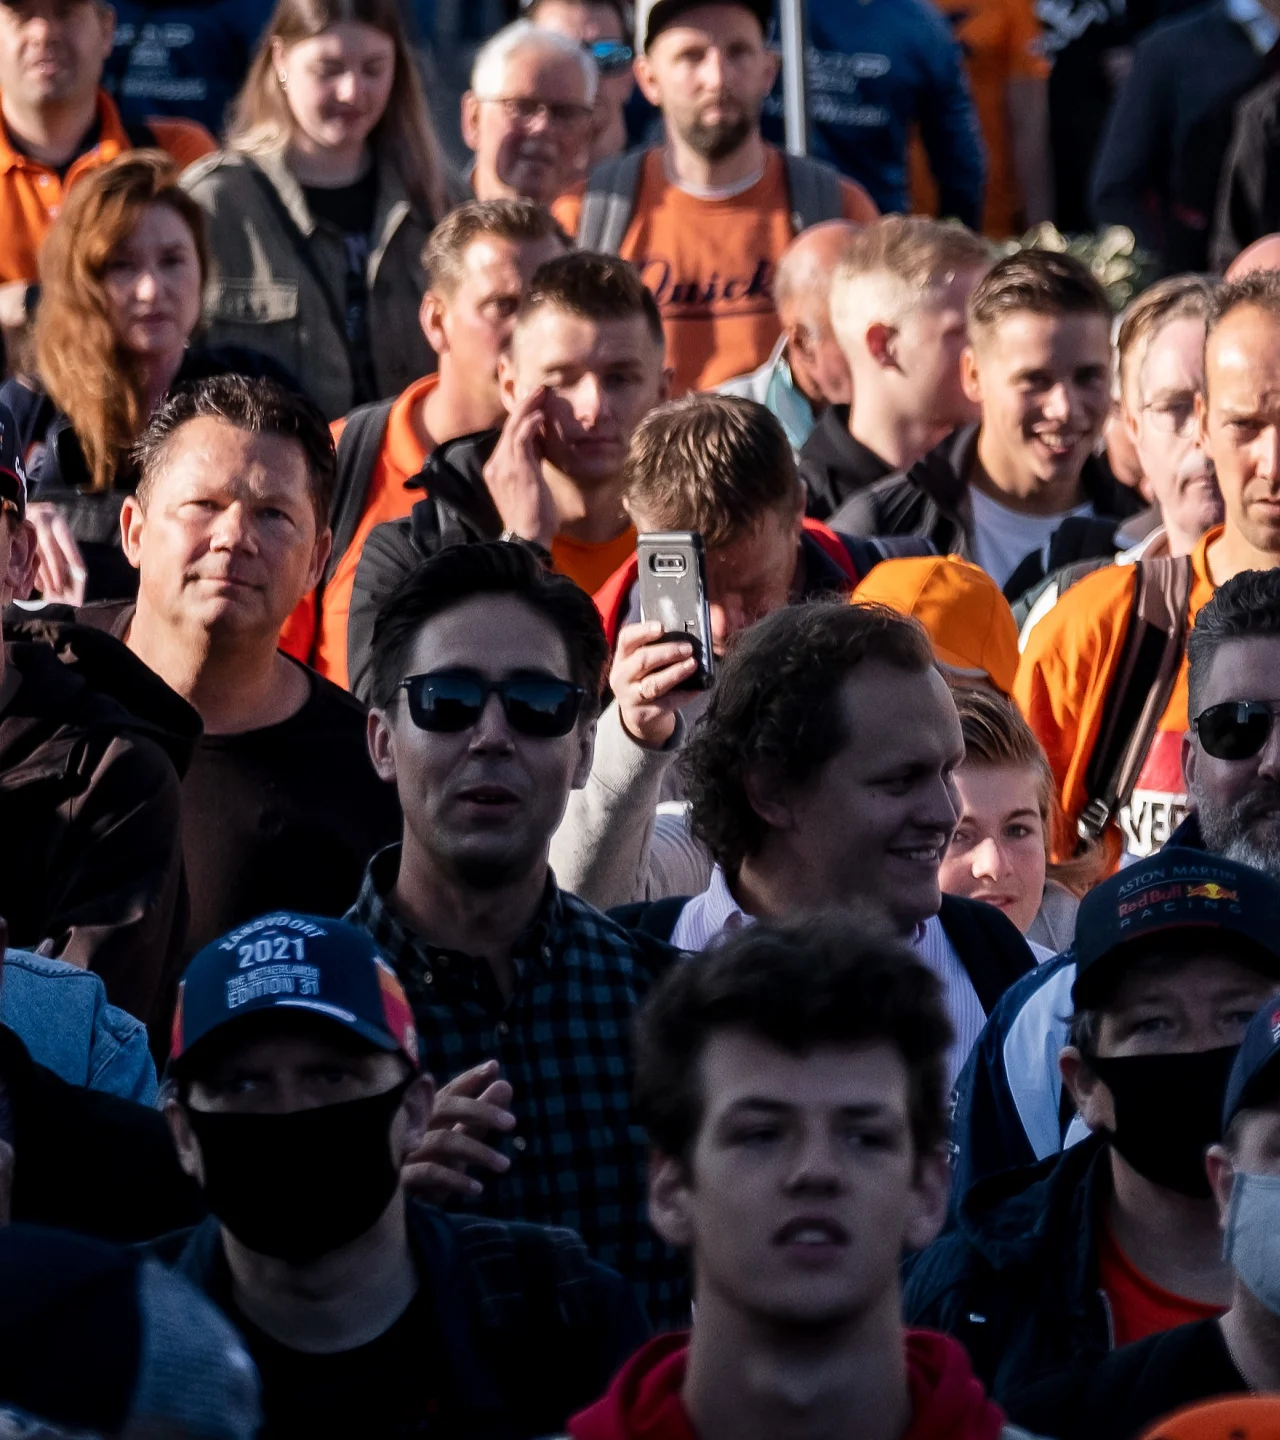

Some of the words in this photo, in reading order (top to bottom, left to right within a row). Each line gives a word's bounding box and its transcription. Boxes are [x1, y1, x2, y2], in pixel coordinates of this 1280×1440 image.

[1117, 868, 1165, 898] ASTON
[1172, 865, 1237, 880] MARTIN
[1120, 899, 1242, 929] RACING
[218, 916, 328, 951] ZANDVOORT
[238, 936, 305, 969] 2021
[228, 978, 295, 1008] EDITION
